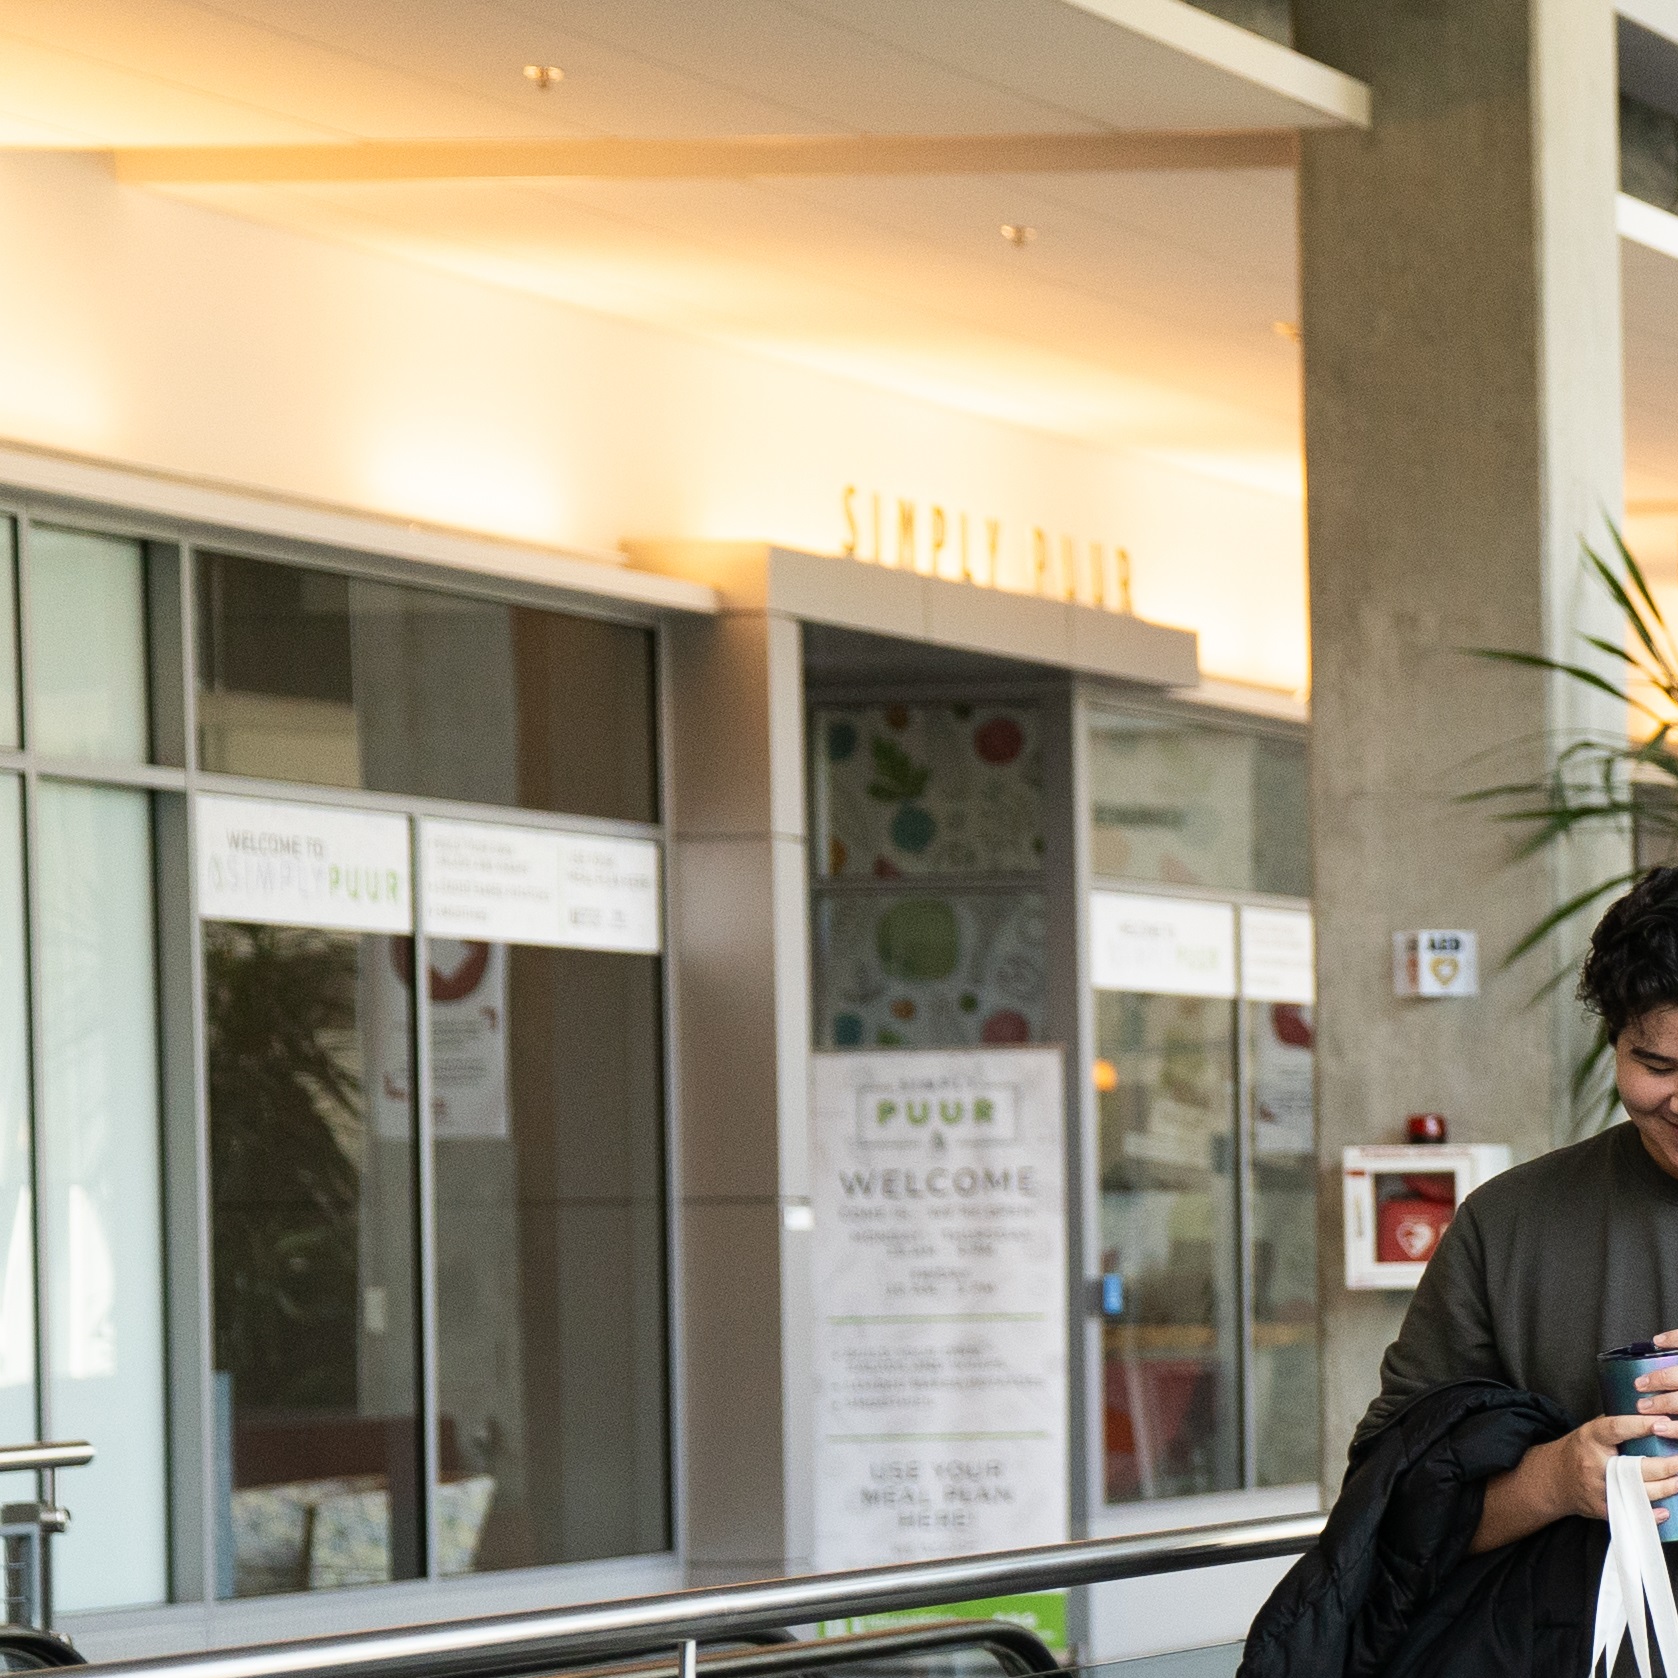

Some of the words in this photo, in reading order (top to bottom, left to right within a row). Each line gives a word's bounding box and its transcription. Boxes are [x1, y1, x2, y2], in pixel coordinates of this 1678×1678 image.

[841, 484, 1001, 589] SIMPLY
[1032, 525, 1133, 615] PUUR
[226, 829, 301, 859] WELCOME
[306, 835, 325, 858] TO
[329, 865, 398, 904] PUUR
[876, 1097, 994, 1127] PUUR
[838, 1166, 1036, 1198] WELCOME
